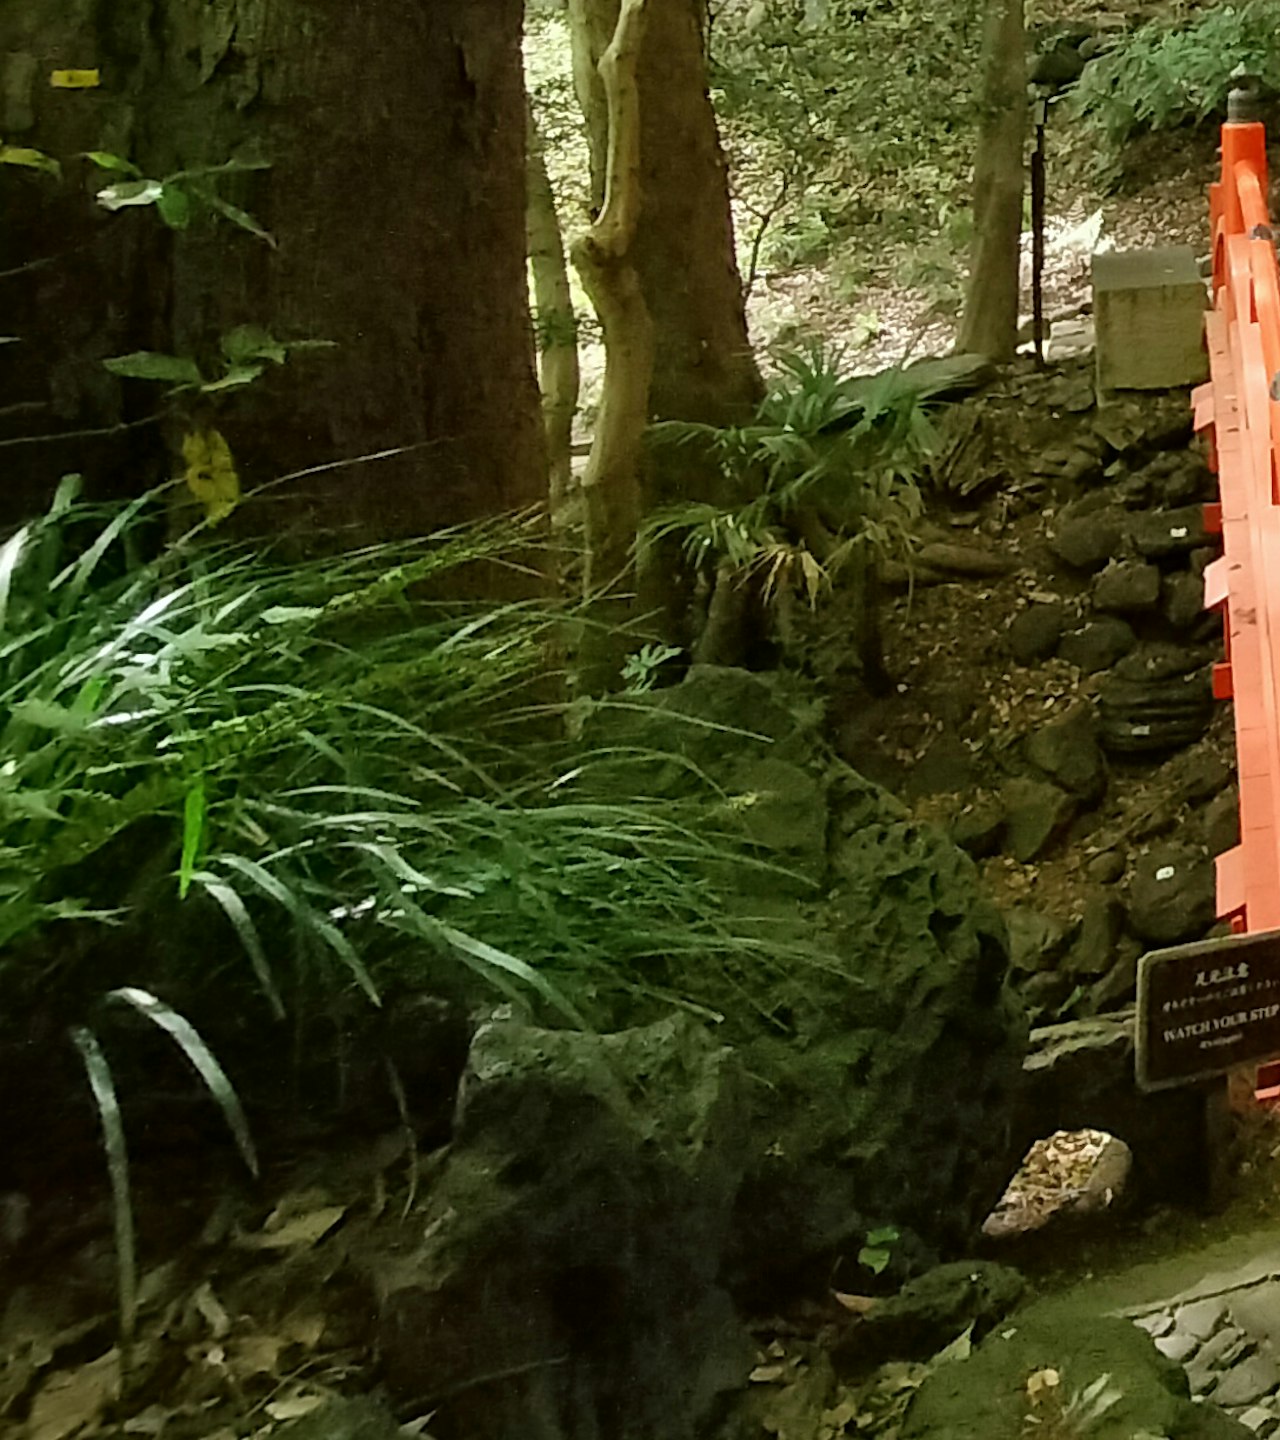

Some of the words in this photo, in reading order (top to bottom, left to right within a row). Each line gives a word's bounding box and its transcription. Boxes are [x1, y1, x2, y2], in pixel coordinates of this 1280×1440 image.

[1163, 1021, 1210, 1042] WATCH
[1212, 1012, 1247, 1030] YOUR
[1250, 1003, 1280, 1021] STEP
